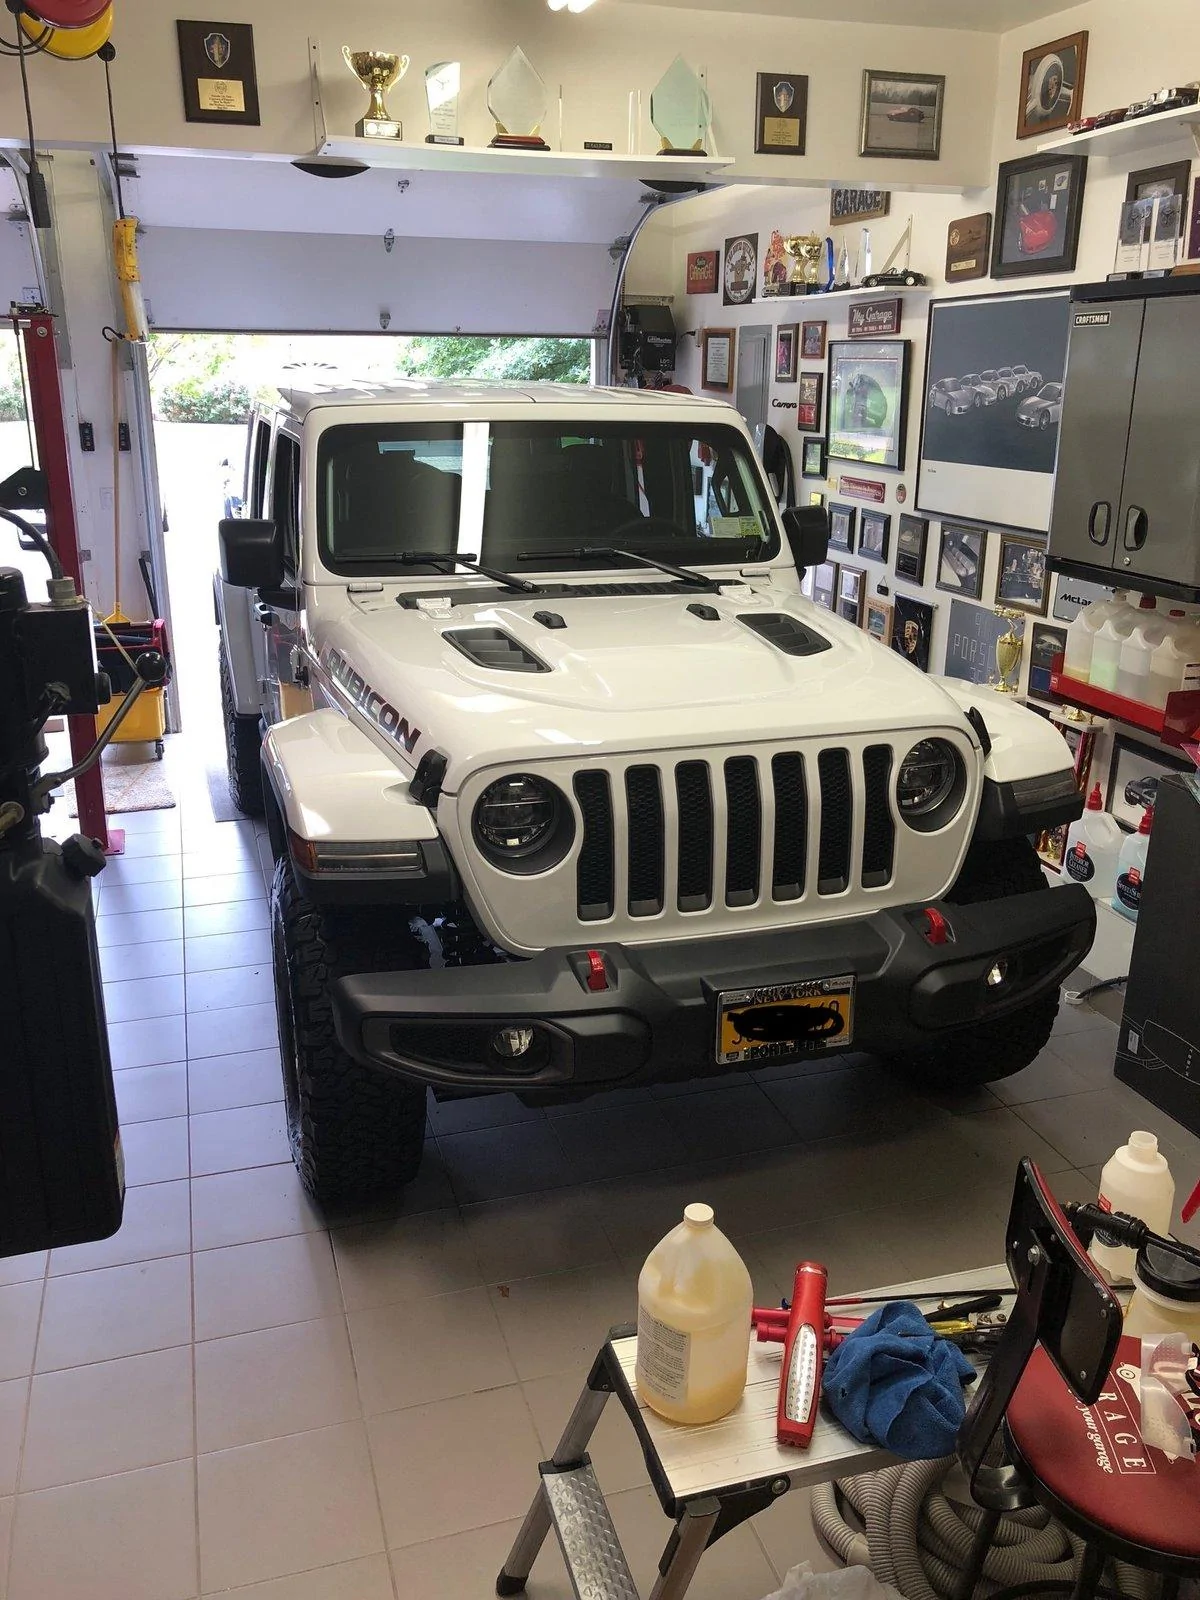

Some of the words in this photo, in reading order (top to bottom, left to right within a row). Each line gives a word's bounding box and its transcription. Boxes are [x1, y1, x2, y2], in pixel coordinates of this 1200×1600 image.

[853, 309, 866, 326] My
[866, 306, 893, 323] Garage
[1075, 315, 1108, 324] CRAFTSMAN
[1060, 593, 1092, 606] McLar
[325, 648, 422, 754] RUBICON
[1075, 1405, 1100, 1432] your
[1097, 1392, 1147, 1468] RAGE
[1087, 1432, 1114, 1474] garage
